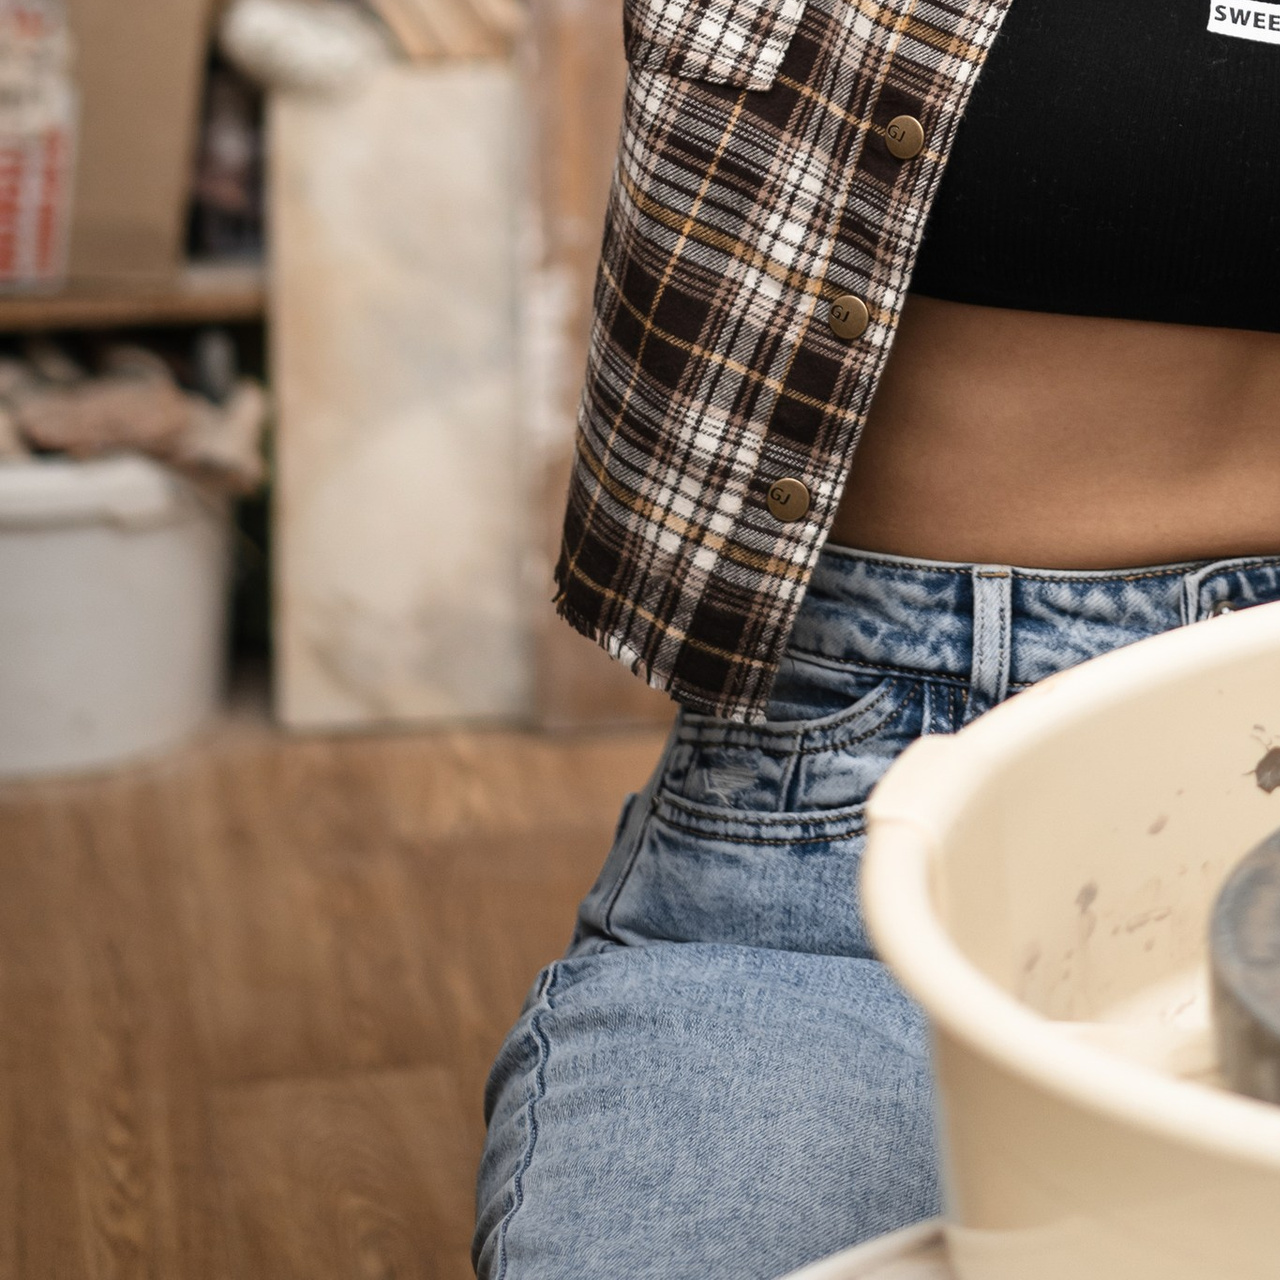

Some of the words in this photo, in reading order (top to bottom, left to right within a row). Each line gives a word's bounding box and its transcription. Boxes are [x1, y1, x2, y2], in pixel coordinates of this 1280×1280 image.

[888, 125, 906, 142] GJ
[831, 305, 850, 322] GJ
[770, 487, 791, 505] GJ
